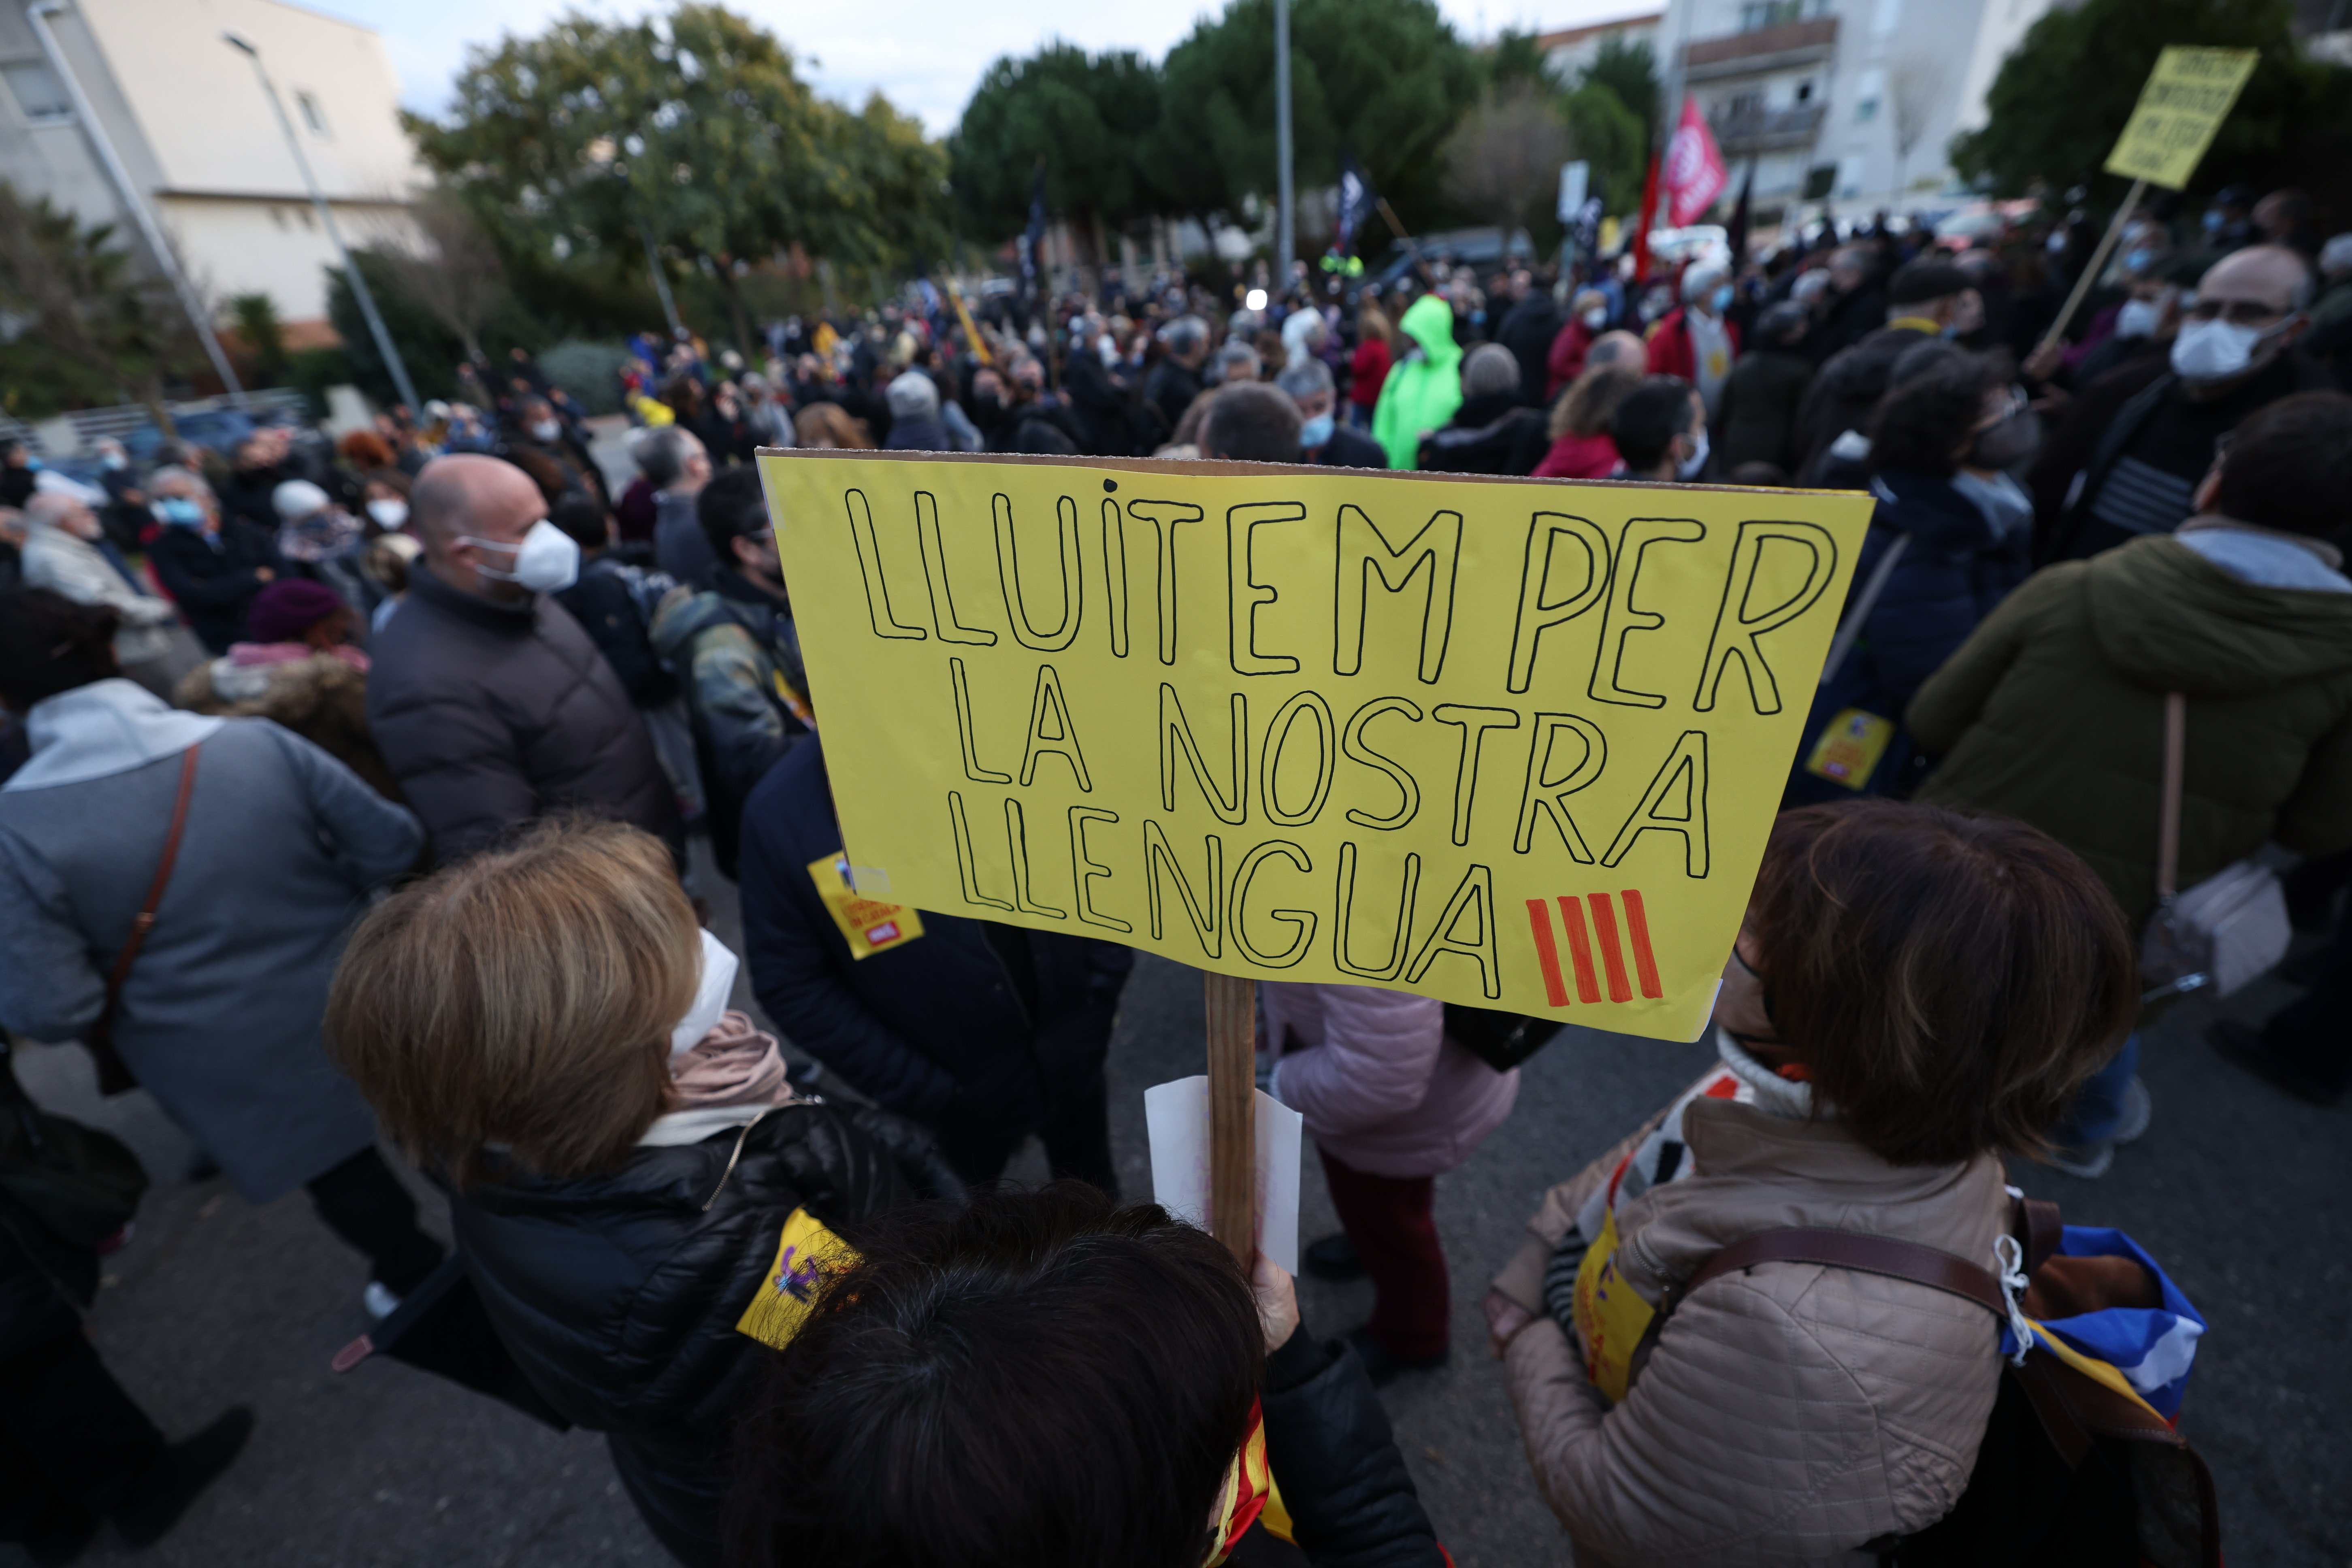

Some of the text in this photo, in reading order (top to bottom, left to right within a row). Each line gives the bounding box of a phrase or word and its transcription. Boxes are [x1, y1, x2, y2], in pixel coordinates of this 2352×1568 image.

[1506, 511, 1838, 716] PER
[949, 656, 1710, 880] LA NOSTRA
[947, 790, 1501, 1000] LLENGUA
